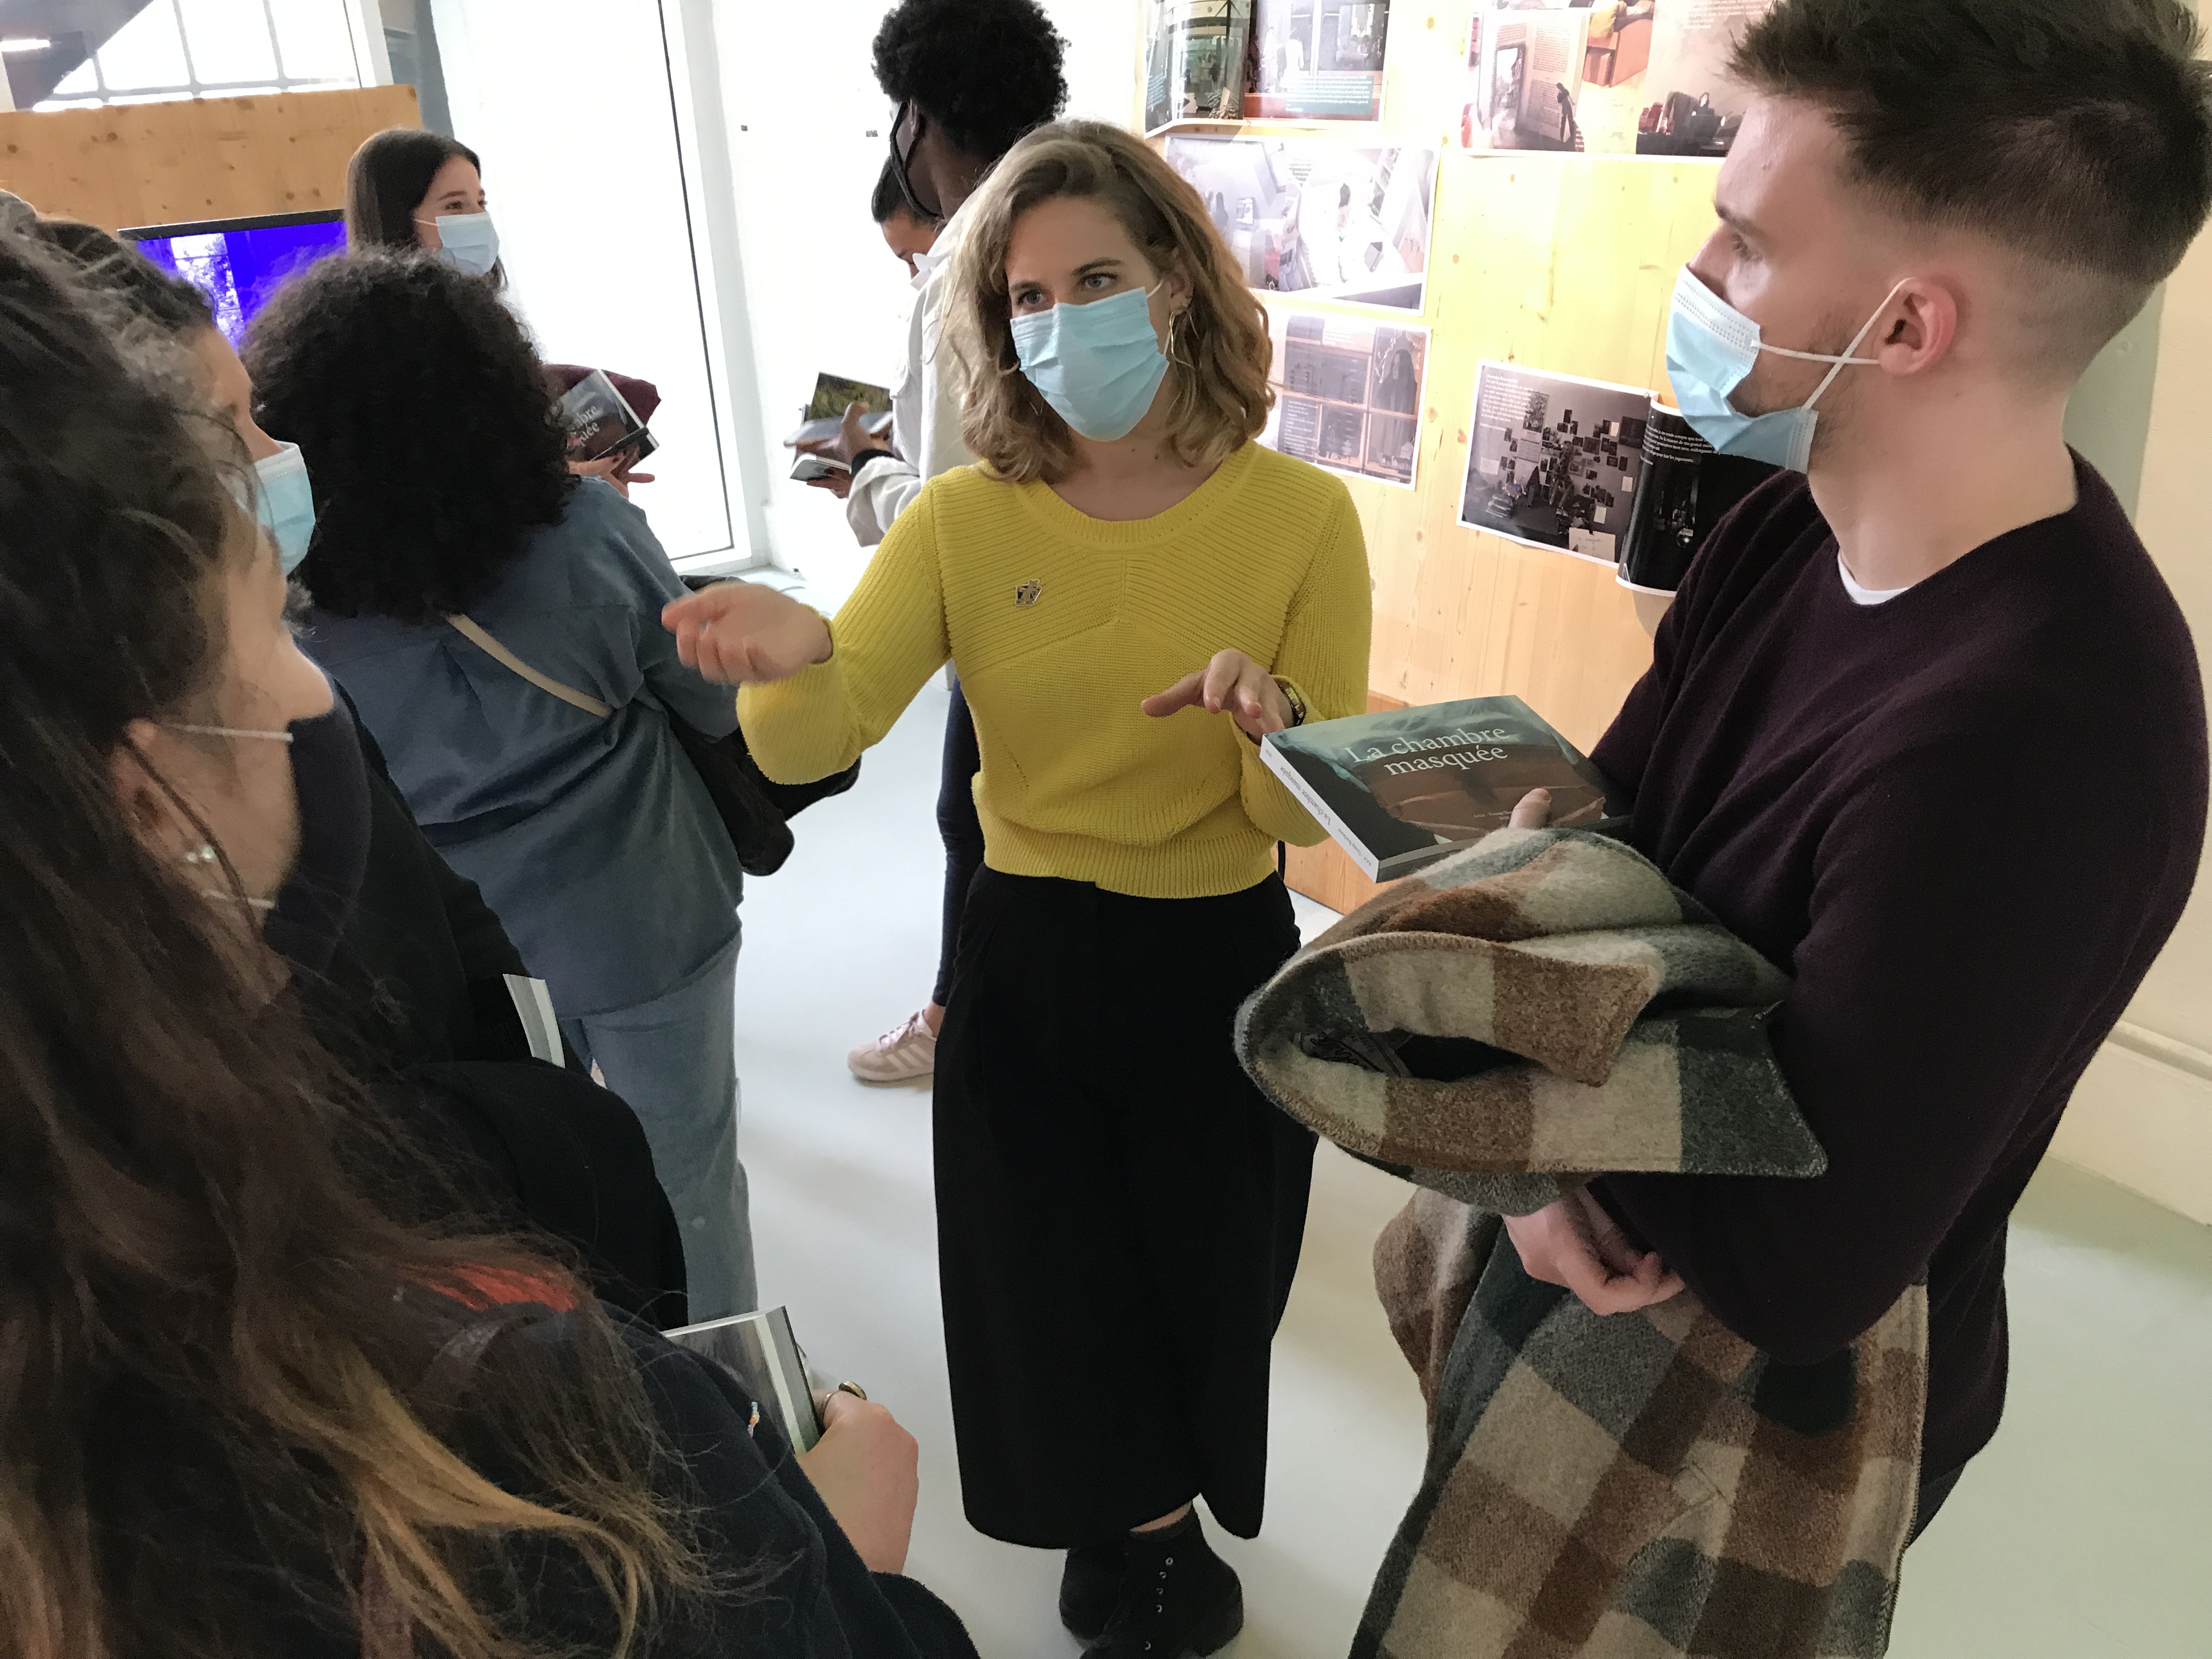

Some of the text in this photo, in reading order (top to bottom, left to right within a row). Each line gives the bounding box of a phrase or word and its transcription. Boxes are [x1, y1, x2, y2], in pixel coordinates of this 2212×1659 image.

[1343, 728, 1510, 763] La chambre
[1384, 745, 1508, 775] masquée
[1280, 765, 1331, 826] La chambre masquée
